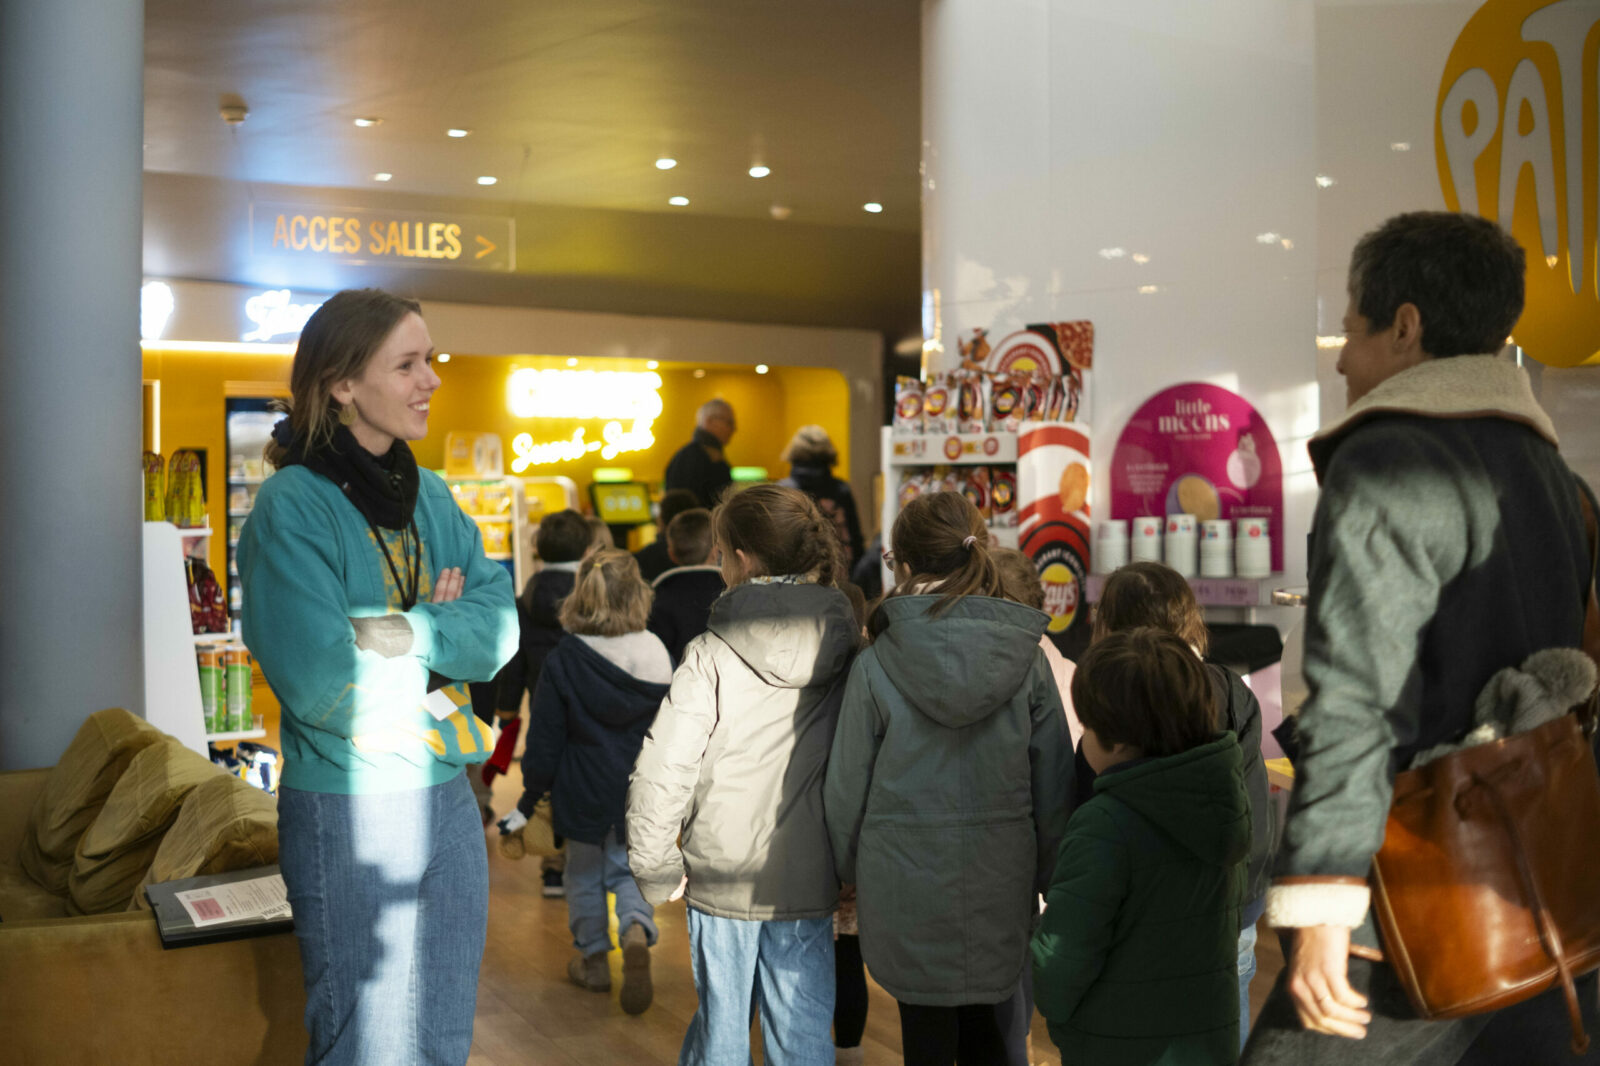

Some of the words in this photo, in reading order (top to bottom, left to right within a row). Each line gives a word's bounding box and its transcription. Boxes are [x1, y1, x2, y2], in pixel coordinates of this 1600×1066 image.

[1440, 0, 1600, 300] PAT
[272, 214, 362, 254] ACCES
[369, 220, 462, 260] SALLES
[1174, 398, 1212, 415] little
[1159, 414, 1230, 433] moons
